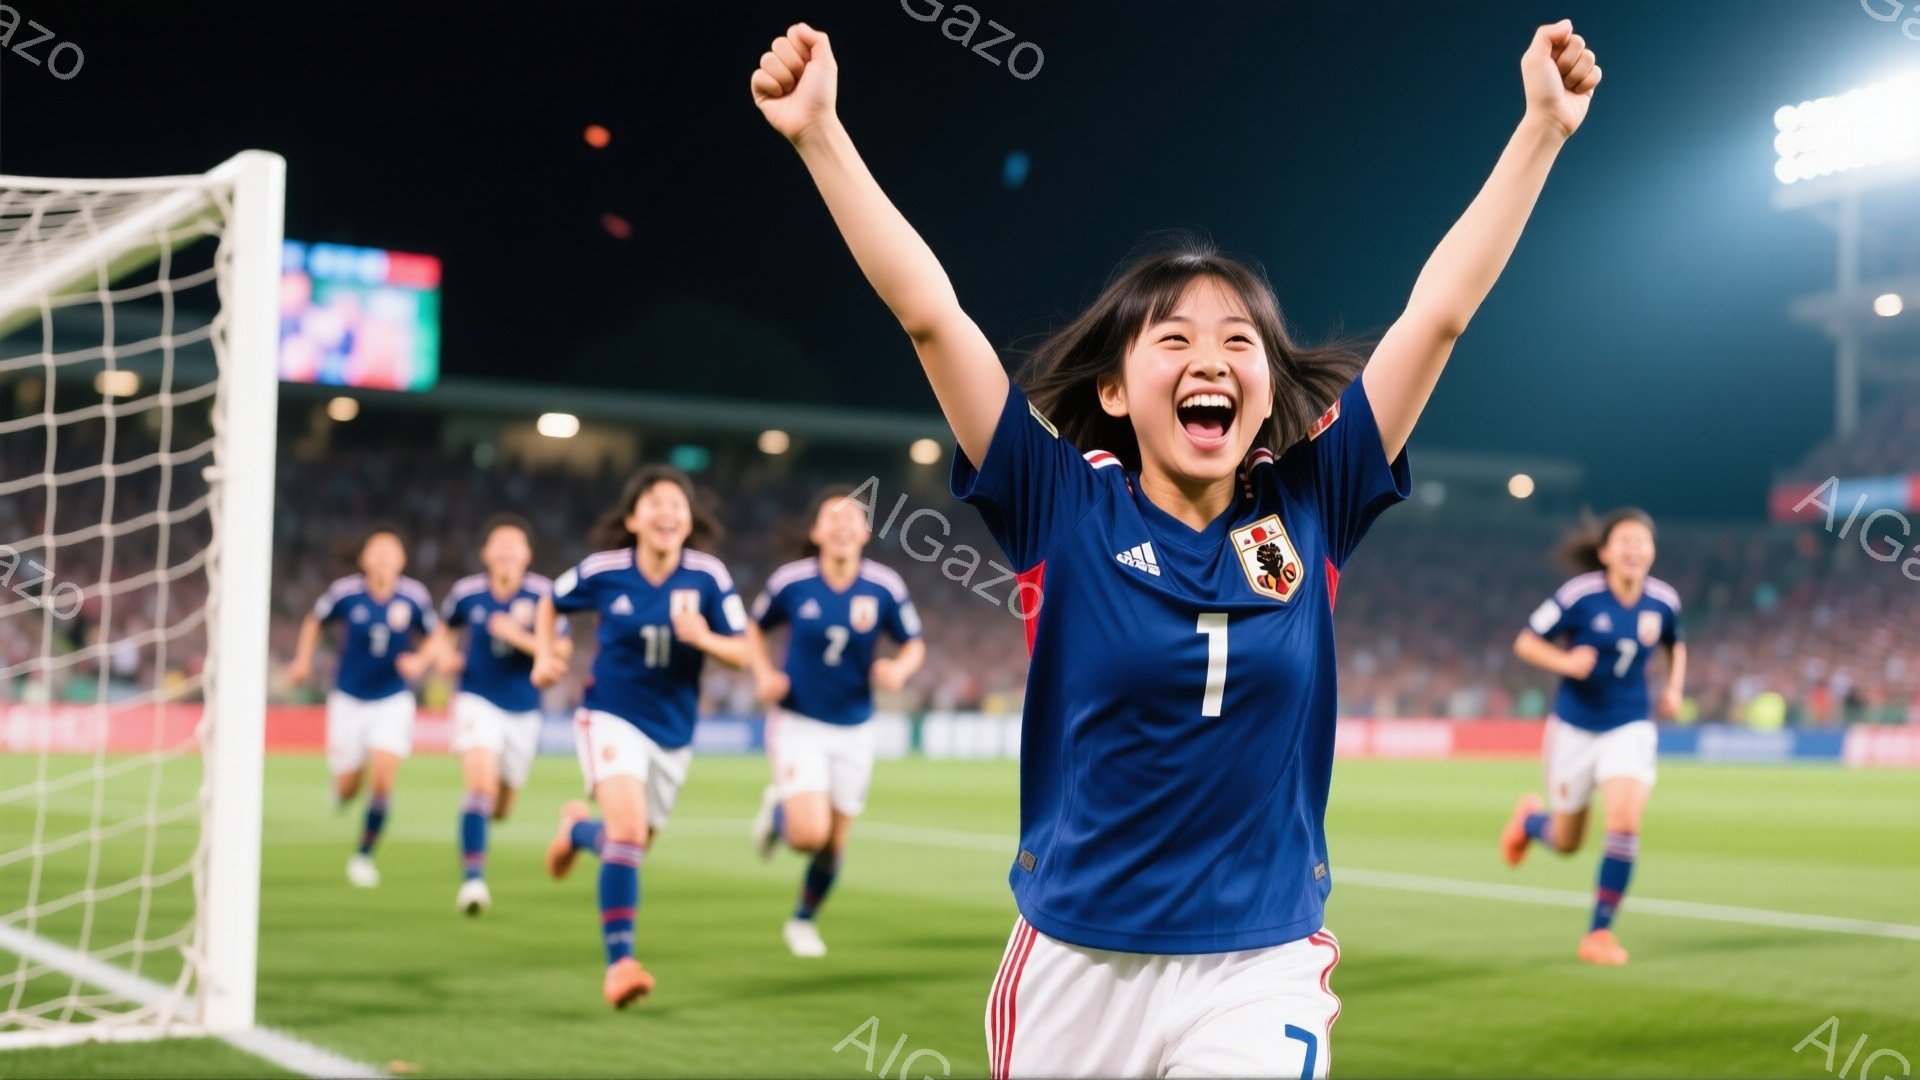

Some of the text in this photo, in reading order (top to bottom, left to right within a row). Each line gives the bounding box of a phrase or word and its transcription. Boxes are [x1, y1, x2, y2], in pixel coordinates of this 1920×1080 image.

[640, 624, 671, 668] 11
[1196, 613, 1229, 717] 1
[1613, 637, 1638, 678] 7
